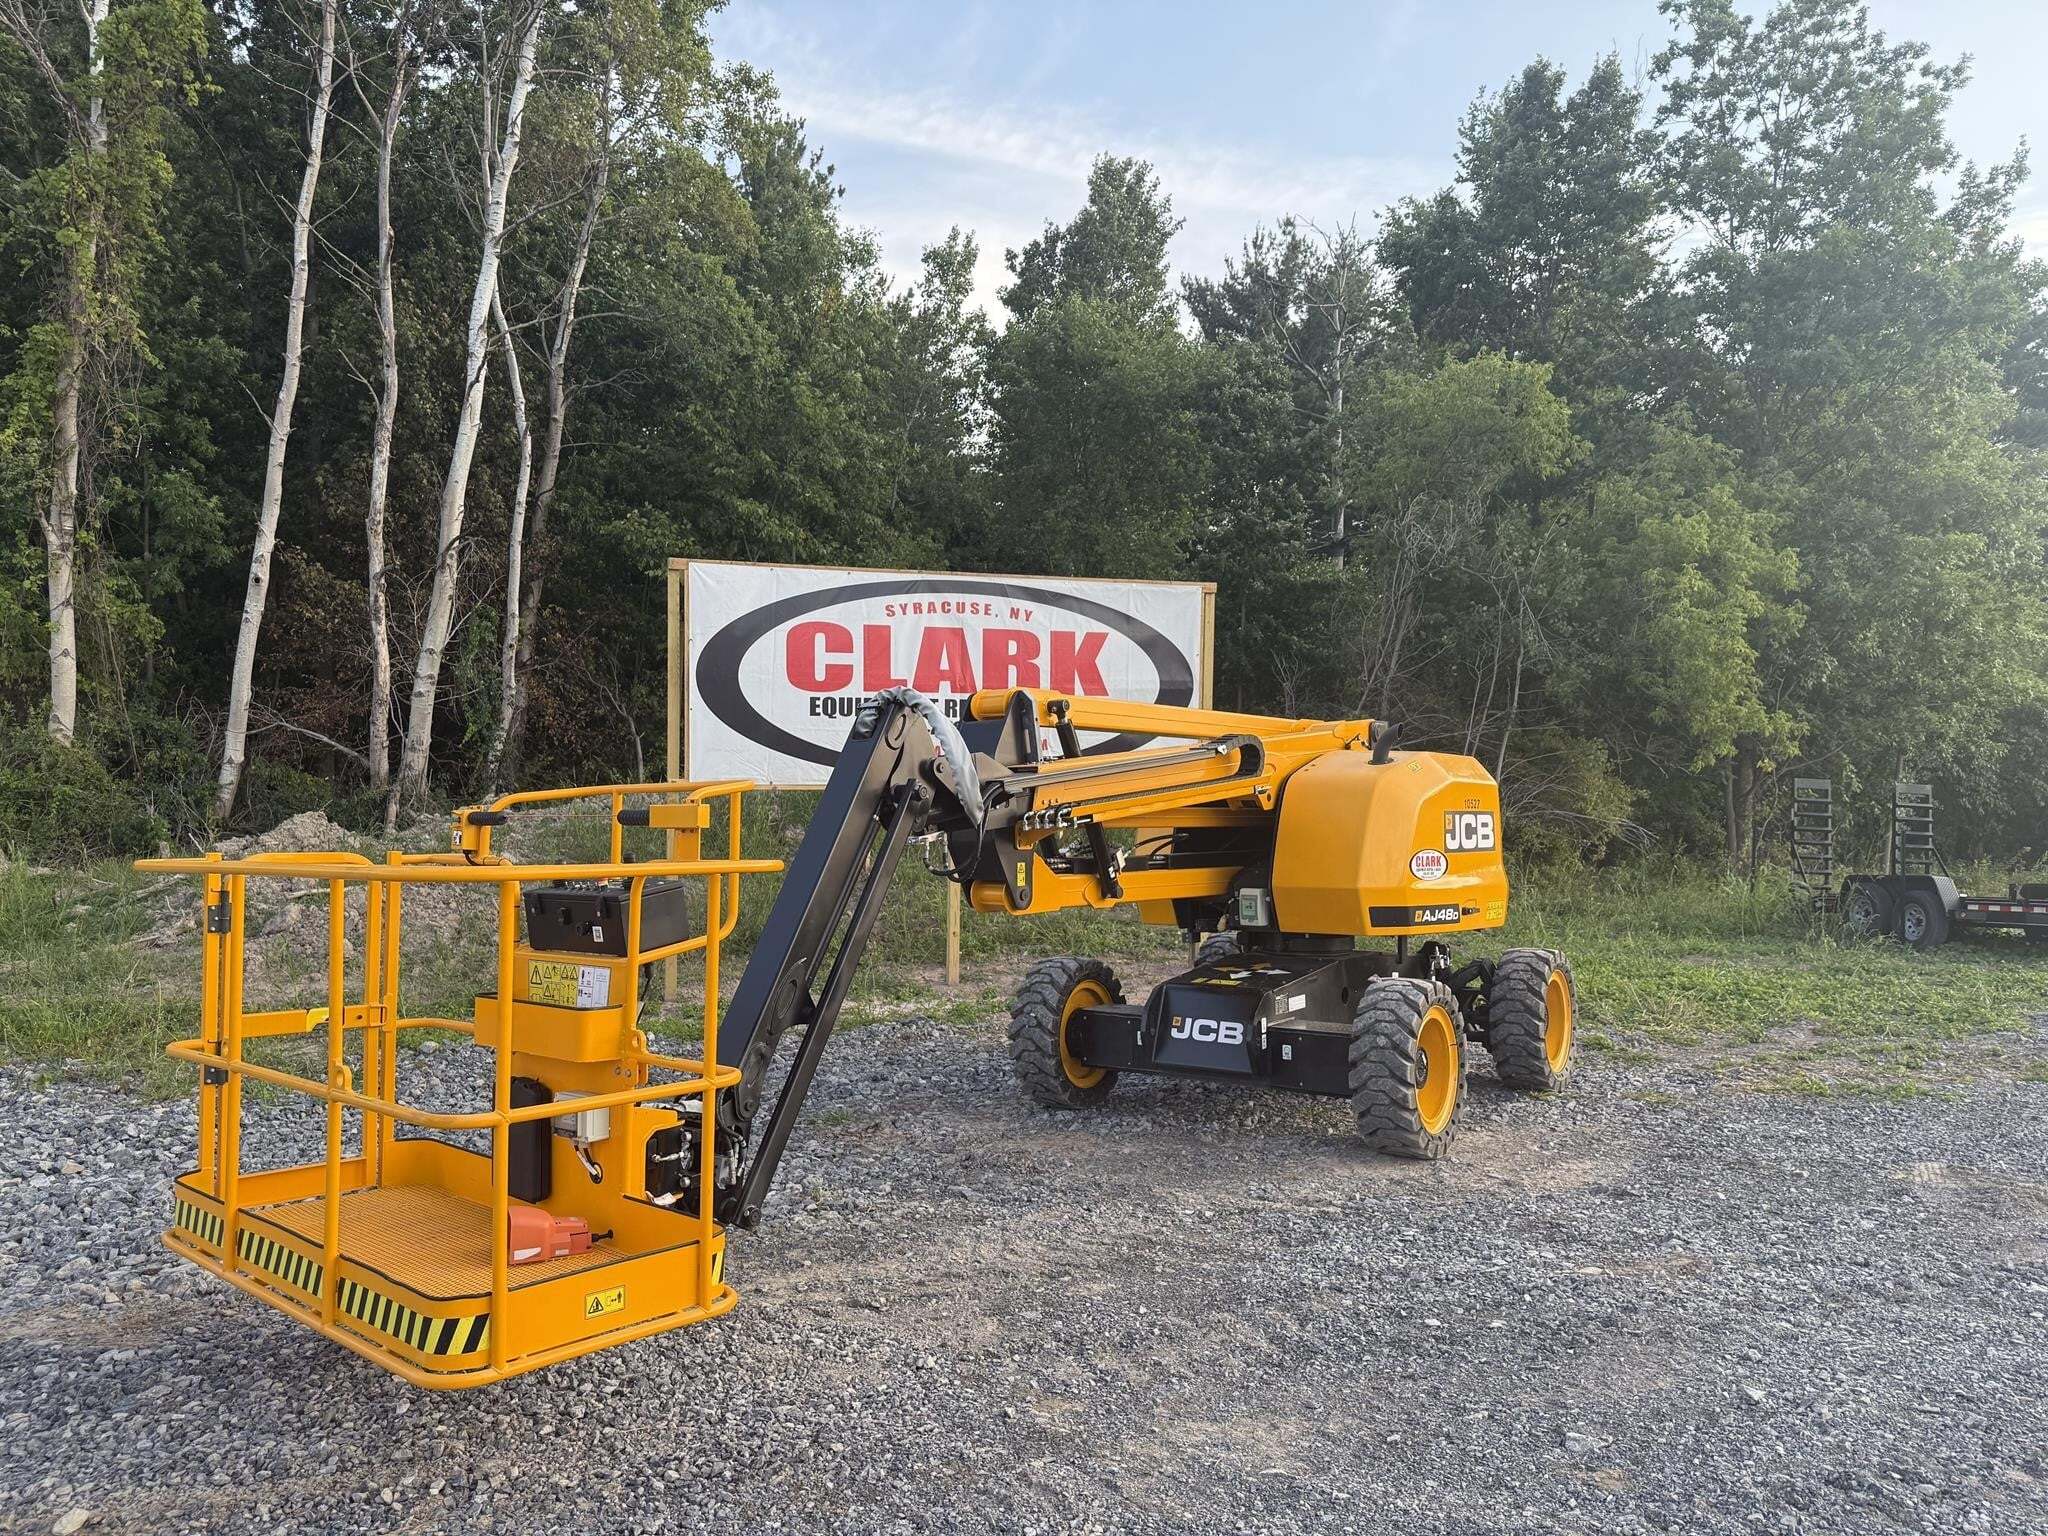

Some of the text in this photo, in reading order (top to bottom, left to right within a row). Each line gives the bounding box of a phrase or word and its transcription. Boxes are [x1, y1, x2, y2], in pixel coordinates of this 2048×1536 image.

[884, 601, 1033, 622] SYRACUSE, NY
[785, 620, 1110, 697] CLARK
[1445, 813, 1495, 850] JCB
[1415, 855, 1442, 868] CLARK
[1170, 1017, 1244, 1045] JCB
